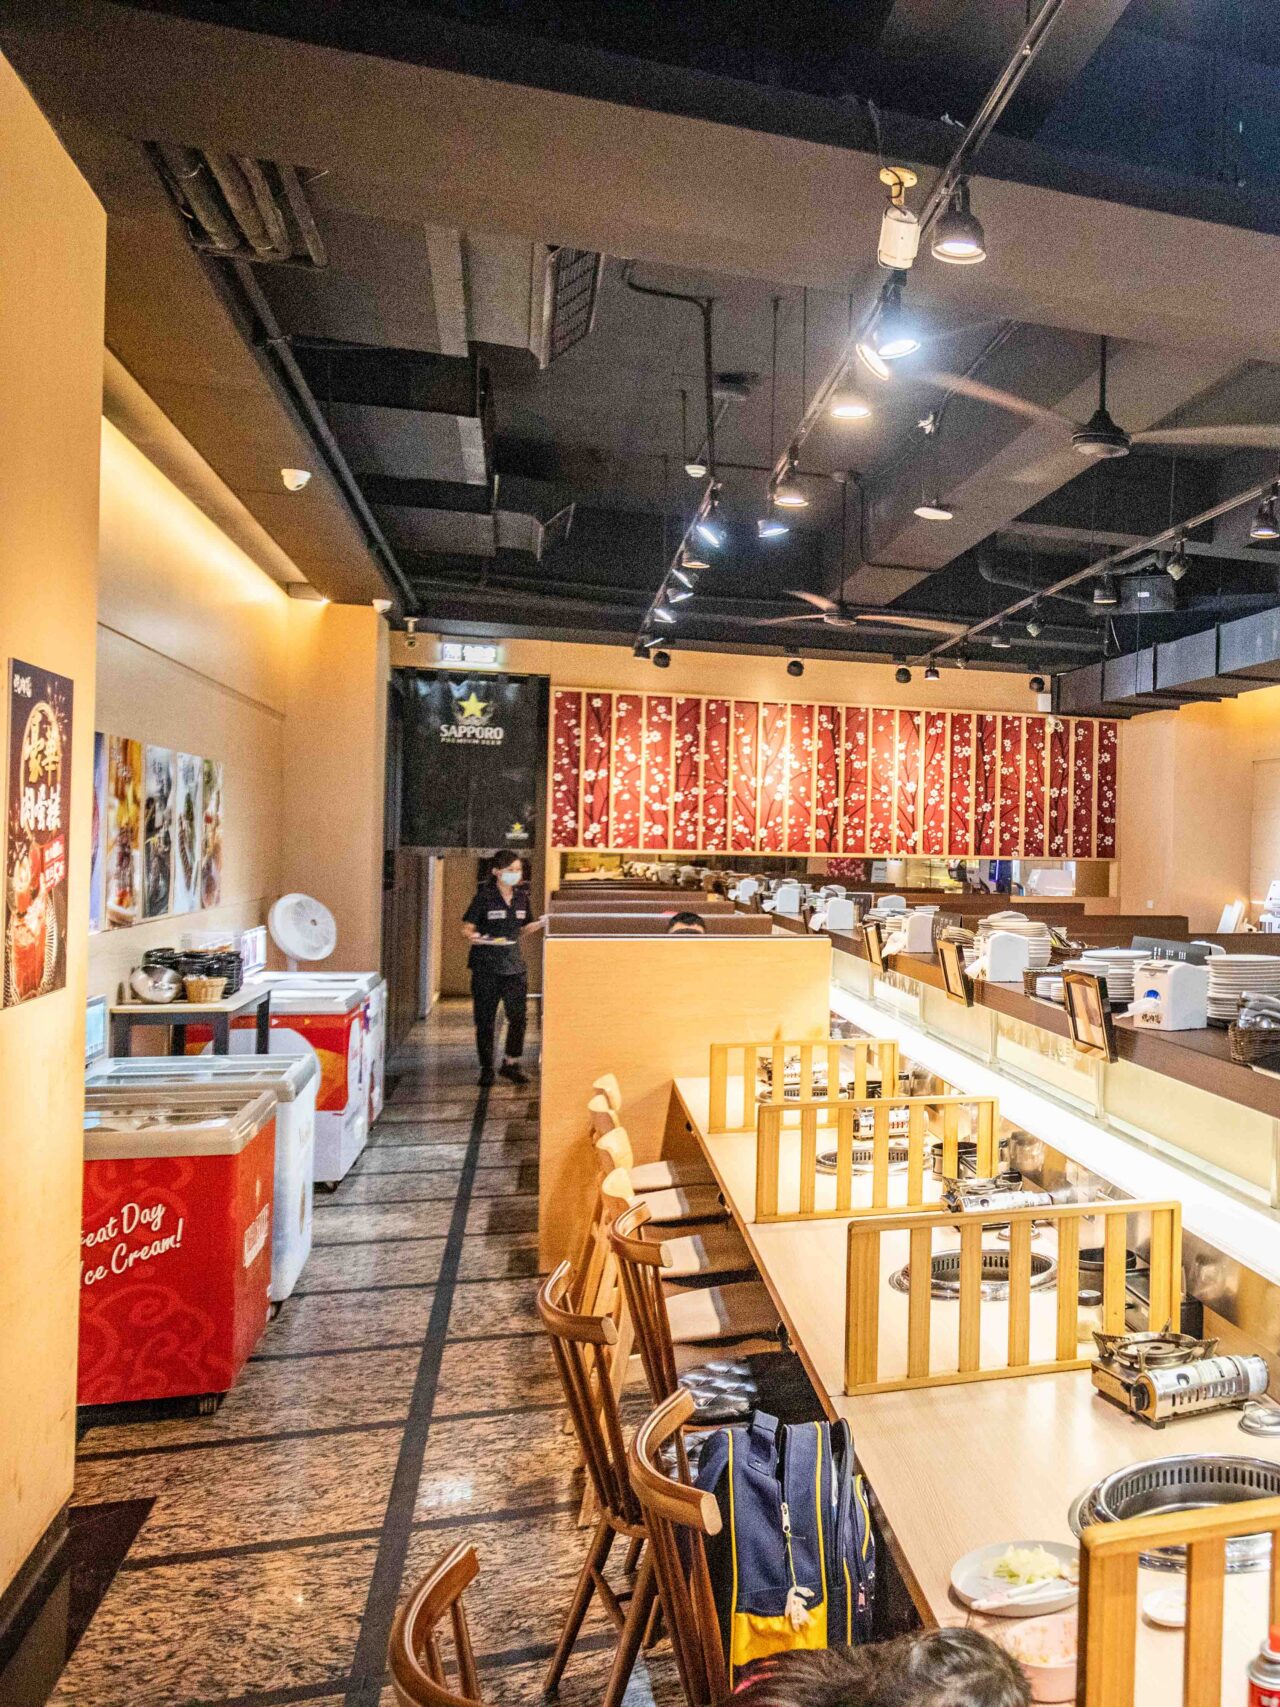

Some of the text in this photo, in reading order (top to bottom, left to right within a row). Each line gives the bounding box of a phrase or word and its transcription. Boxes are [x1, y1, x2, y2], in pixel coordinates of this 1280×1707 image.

[440, 724, 504, 740] SAPPORO
[121, 1203, 167, 1234] Day
[111, 1217, 184, 1274] Cream!
